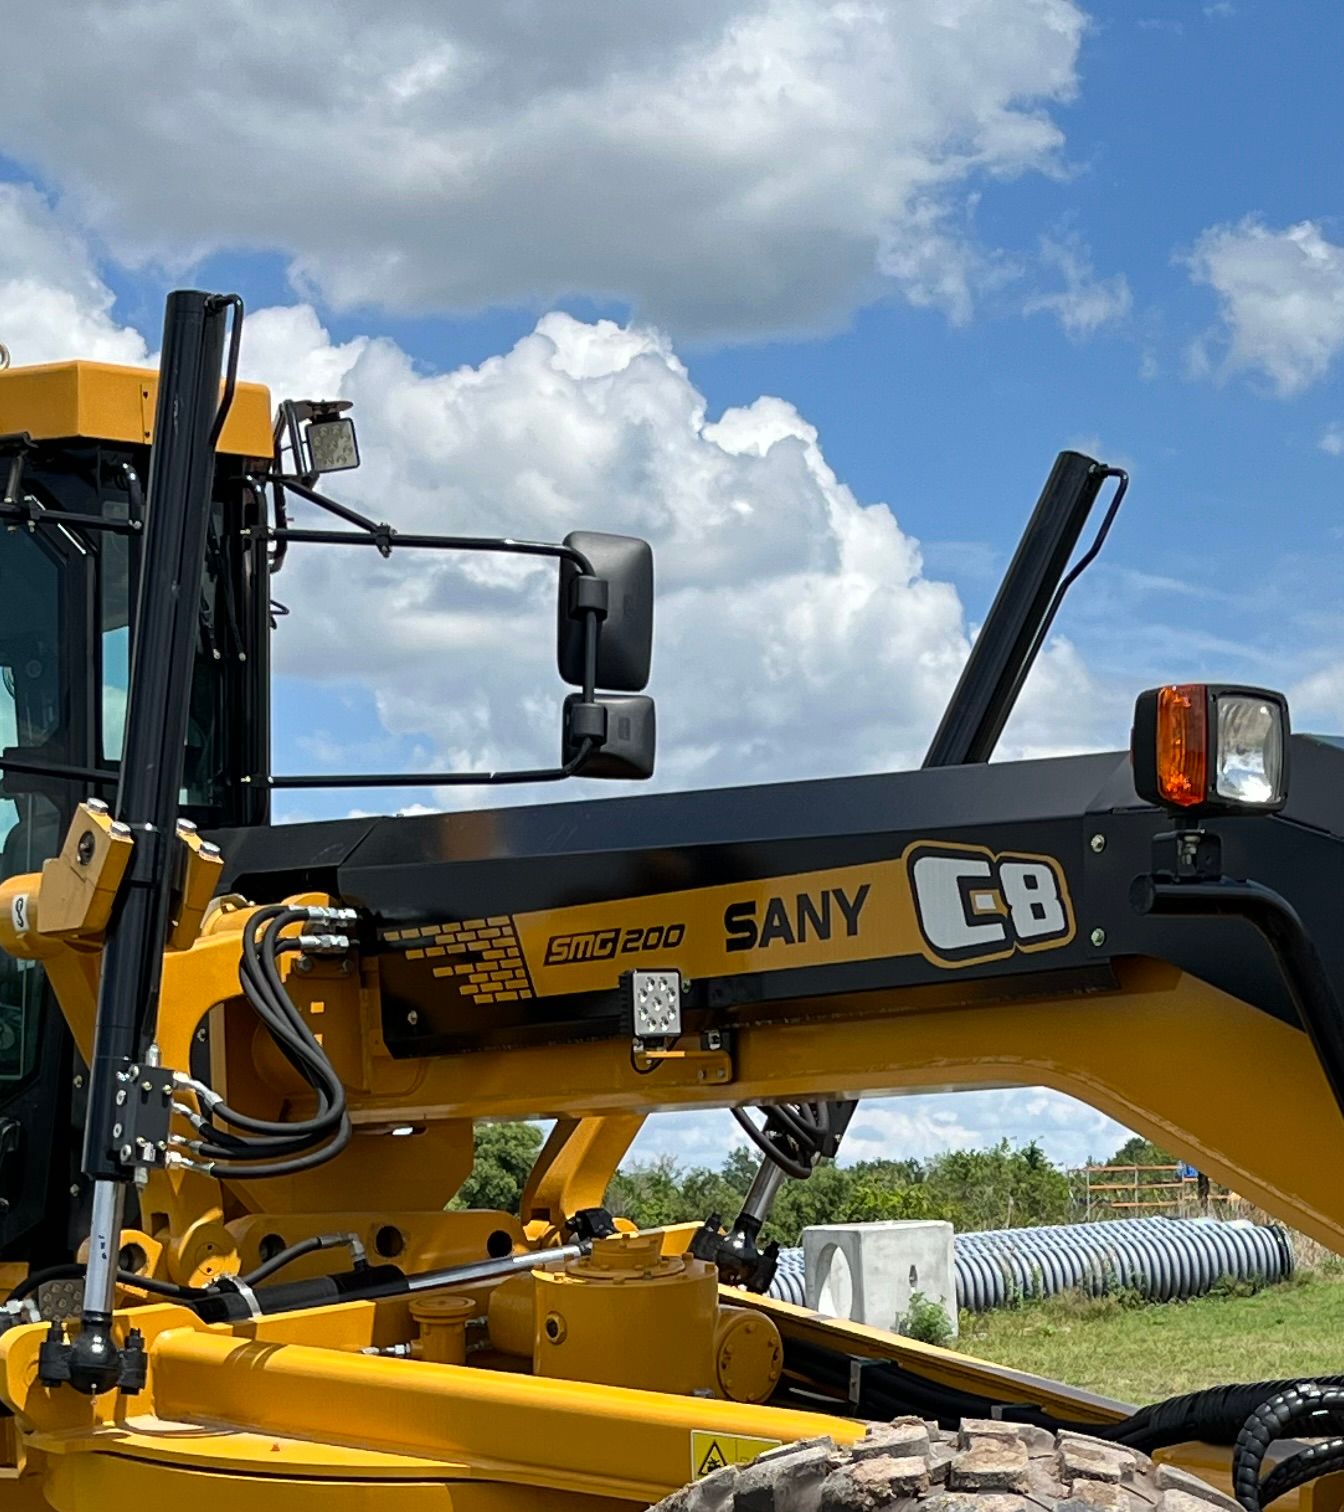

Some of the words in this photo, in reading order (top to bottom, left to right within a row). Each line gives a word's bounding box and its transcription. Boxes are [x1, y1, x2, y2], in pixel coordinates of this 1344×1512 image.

[545, 929, 619, 965] SMG
[621, 924, 686, 953] 200
[723, 884, 871, 953] SANY
